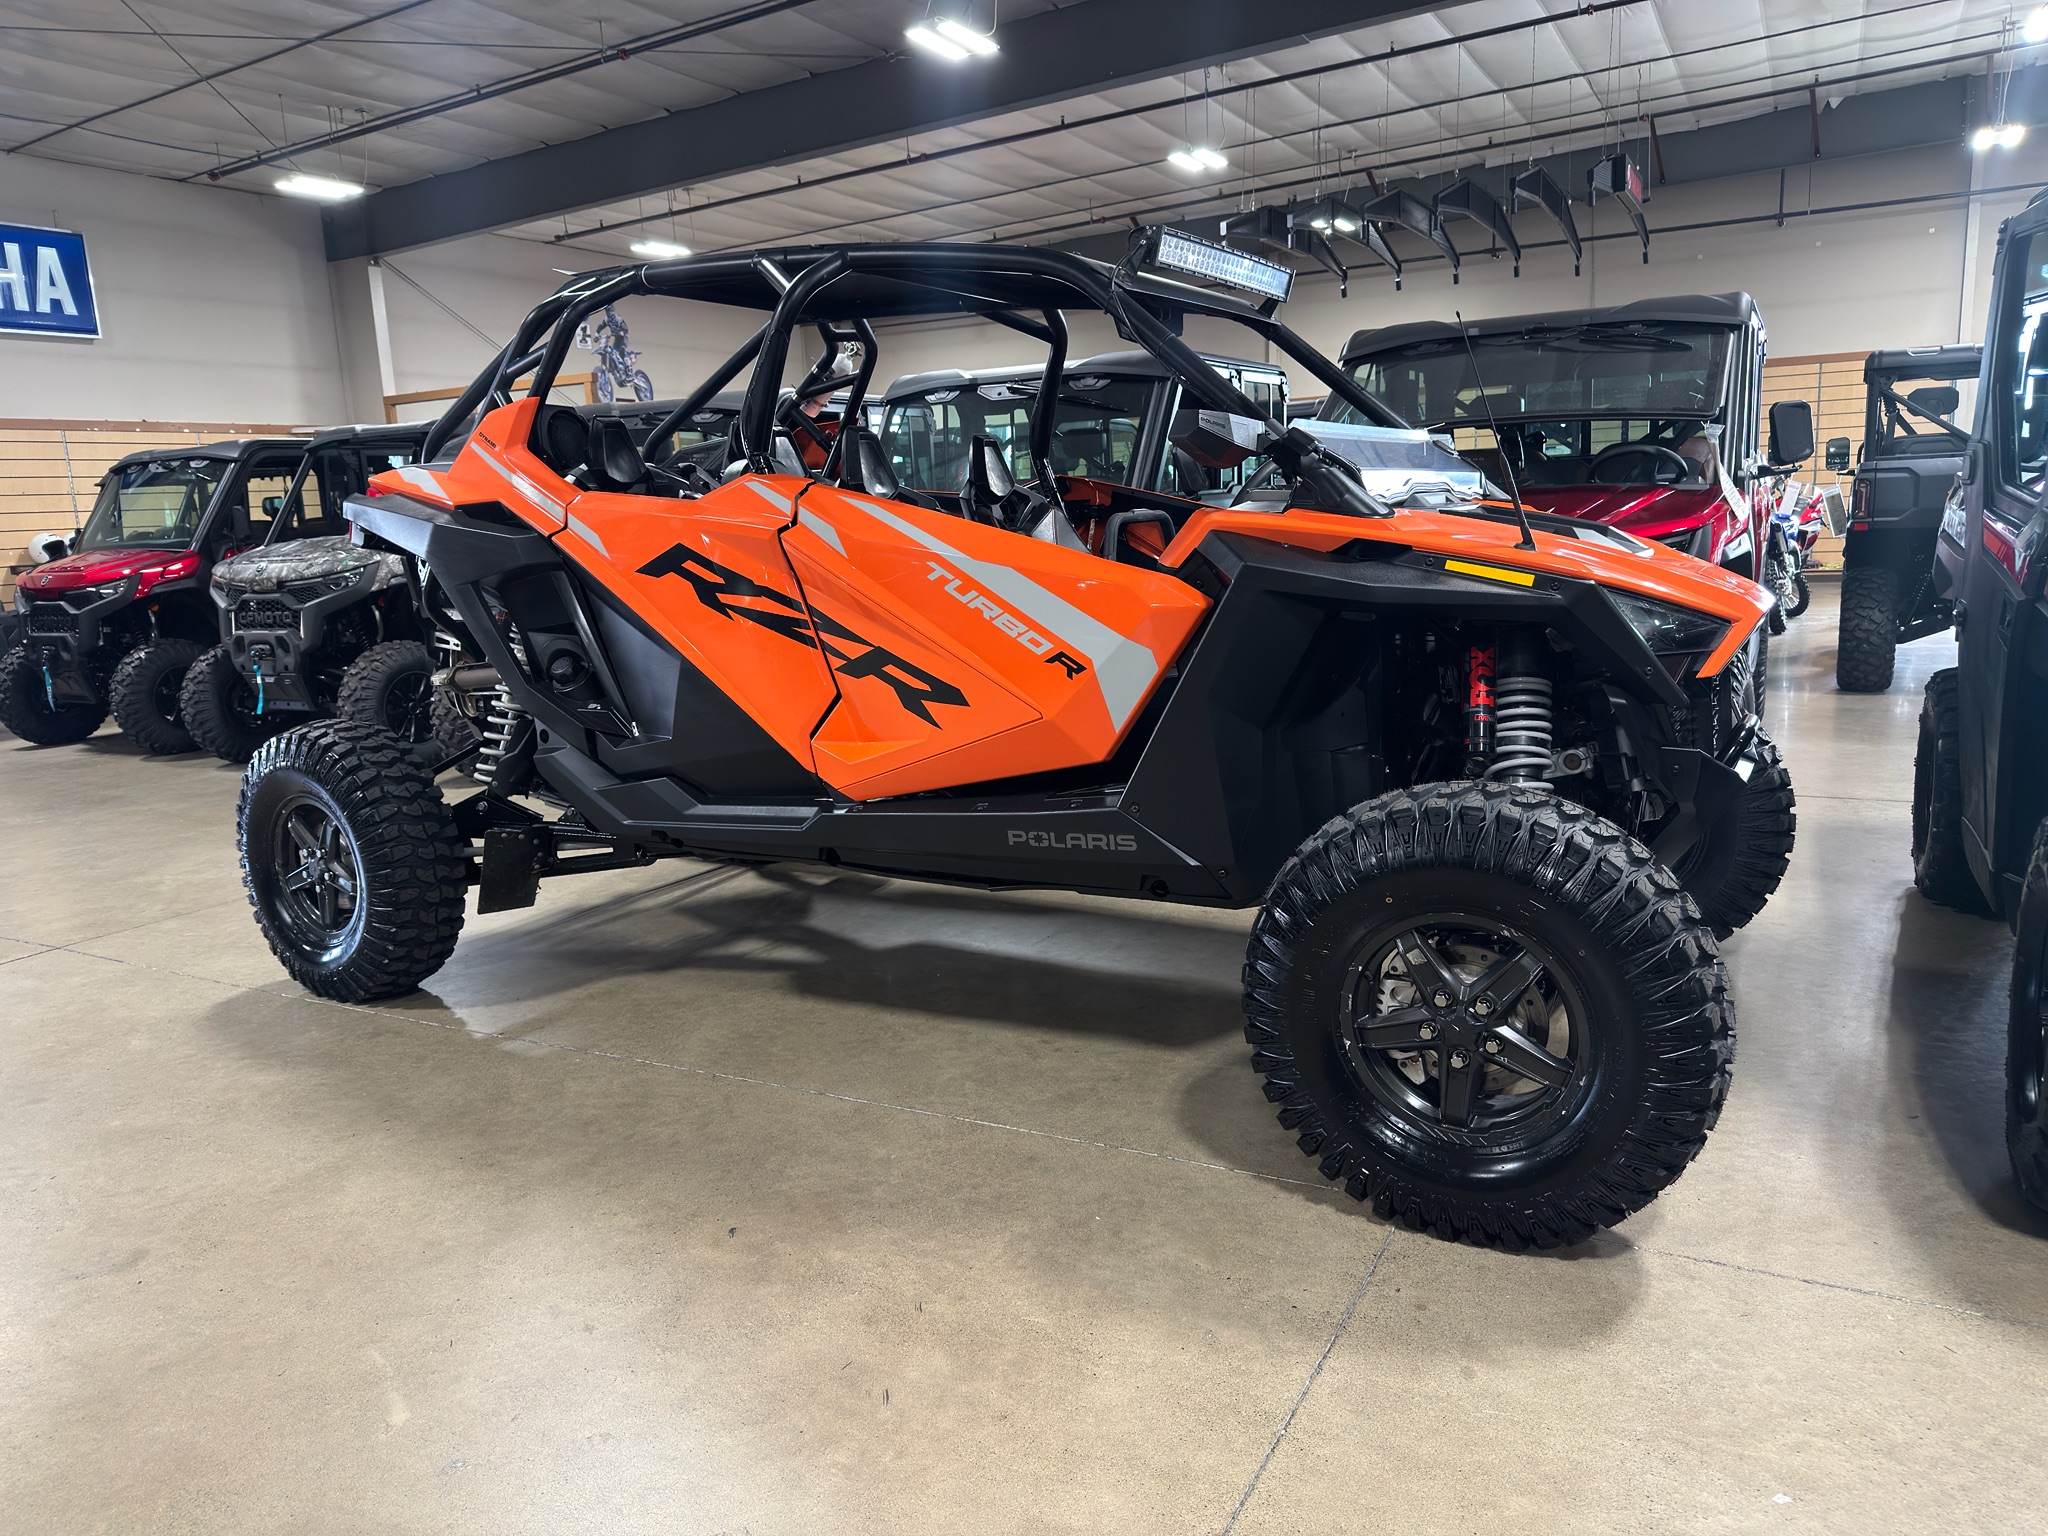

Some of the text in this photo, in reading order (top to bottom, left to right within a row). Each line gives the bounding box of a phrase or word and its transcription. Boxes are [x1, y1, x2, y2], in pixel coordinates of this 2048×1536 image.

[1200, 416, 1227, 429] POLARIS
[238, 611, 293, 624] CFMOTO
[634, 542, 971, 730] RZR
[926, 561, 1087, 681] TURBO R
[1469, 646, 1497, 708] FOX
[1007, 830, 1138, 851] POLARIS
